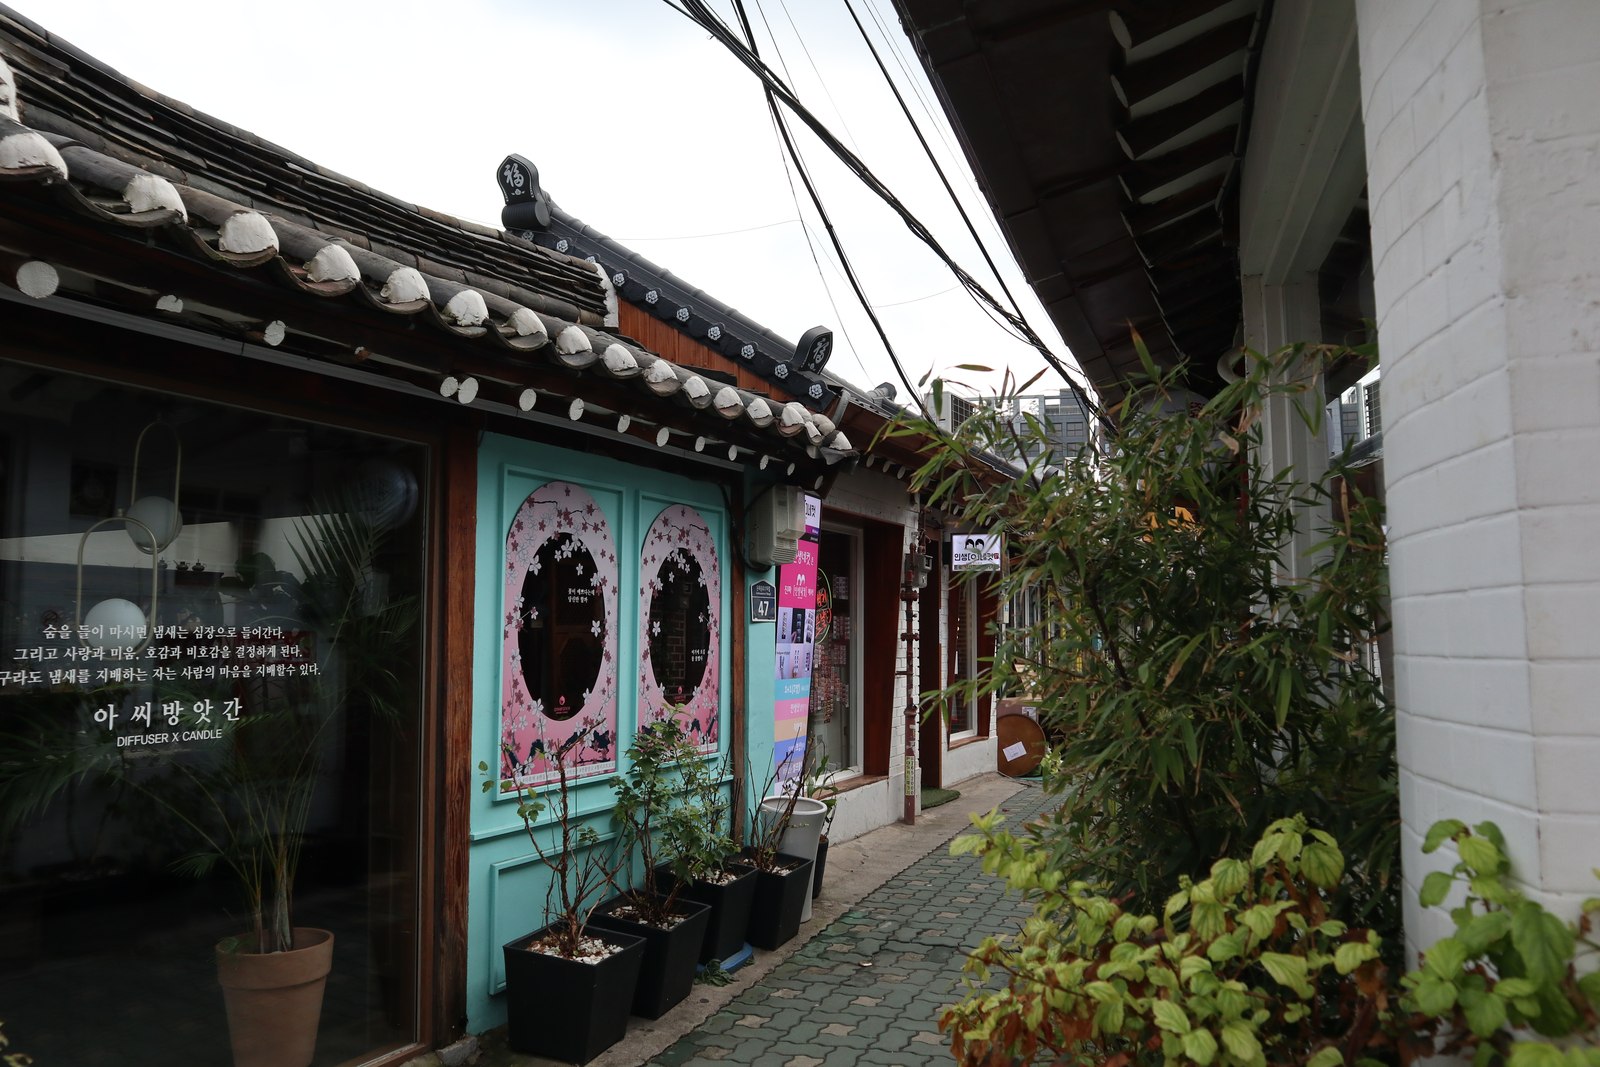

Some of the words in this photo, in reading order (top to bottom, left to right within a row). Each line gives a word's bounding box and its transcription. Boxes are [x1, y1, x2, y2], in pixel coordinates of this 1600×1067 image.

[758, 600, 769, 616] 47
[42, 625, 72, 639] 숨을
[77, 625, 103, 639] 들이
[109, 624, 147, 639] 마시면
[153, 625, 188, 639] 냄새는
[193, 626, 237, 639] 심장으로
[241, 626, 285, 639] 들어간다.
[13, 647, 58, 662] 그리고
[63, 646, 105, 661] 사랑과
[145, 646, 182, 659] 호감과
[186, 646, 229, 659] 비호감을
[235, 645, 276, 658] 결정하게
[280, 645, 302, 658] 된다.
[49, 669, 91, 684] 냄새를
[96, 667, 148, 683] 지배하는
[152, 667, 176, 681] 자는
[181, 666, 215, 680] 사람의
[219, 665, 252, 679] 마음을
[256, 665, 296, 677] 지배할수
[300, 664, 321, 676] 있다.
[117, 733, 168, 747] DIFFUSER
[172, 732, 178, 741] X
[182, 729, 222, 741] CANDLE
